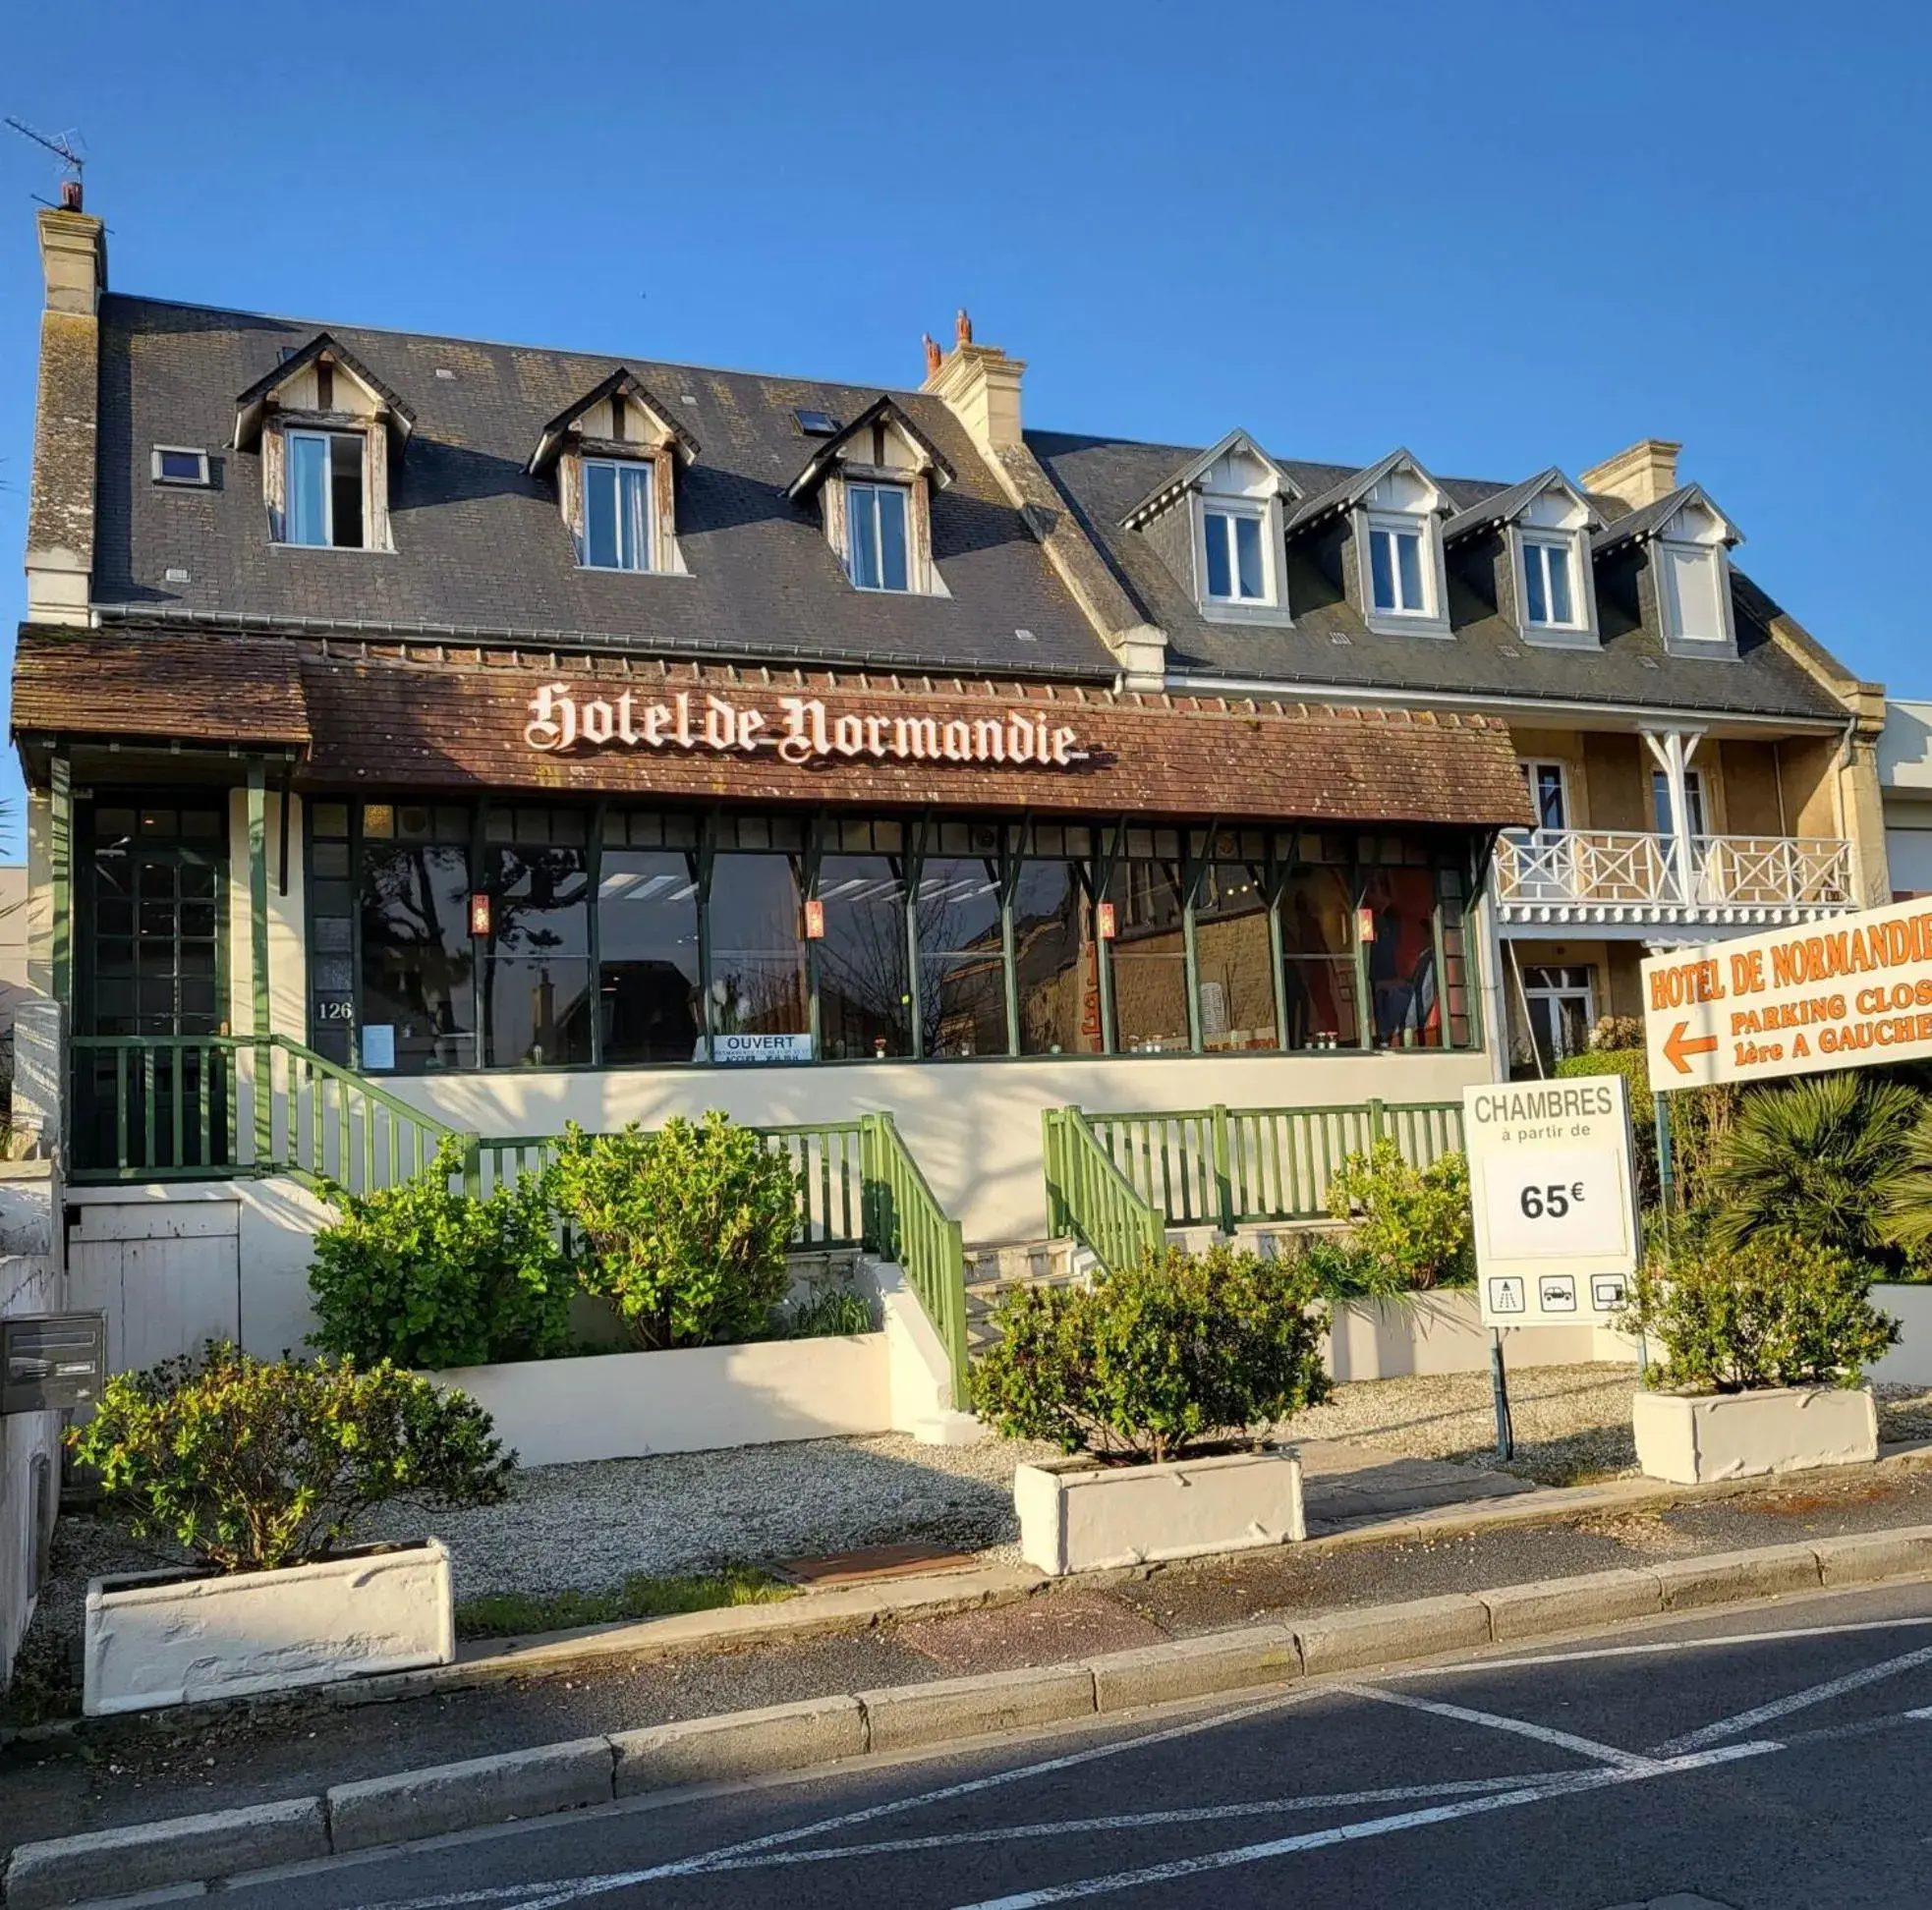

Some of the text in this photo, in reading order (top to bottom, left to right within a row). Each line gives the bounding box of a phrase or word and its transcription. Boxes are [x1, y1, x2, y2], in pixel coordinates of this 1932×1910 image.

[526, 682, 1078, 766] Hotel de Normandie
[1649, 912, 1932, 1011] HOTEL DE NORMANDIE
[319, 1002, 352, 1020] 126
[1731, 979, 1932, 1037] PARKING CLOS
[727, 1036, 794, 1049] OUVERT
[1791, 1033, 1811, 1058] A
[1818, 1012, 1932, 1054] GAUCHE
[1475, 1086, 1613, 1124] CHAMBRES
[1502, 1123, 1591, 1144] à partir de
[1520, 1181, 1586, 1219] 65€
